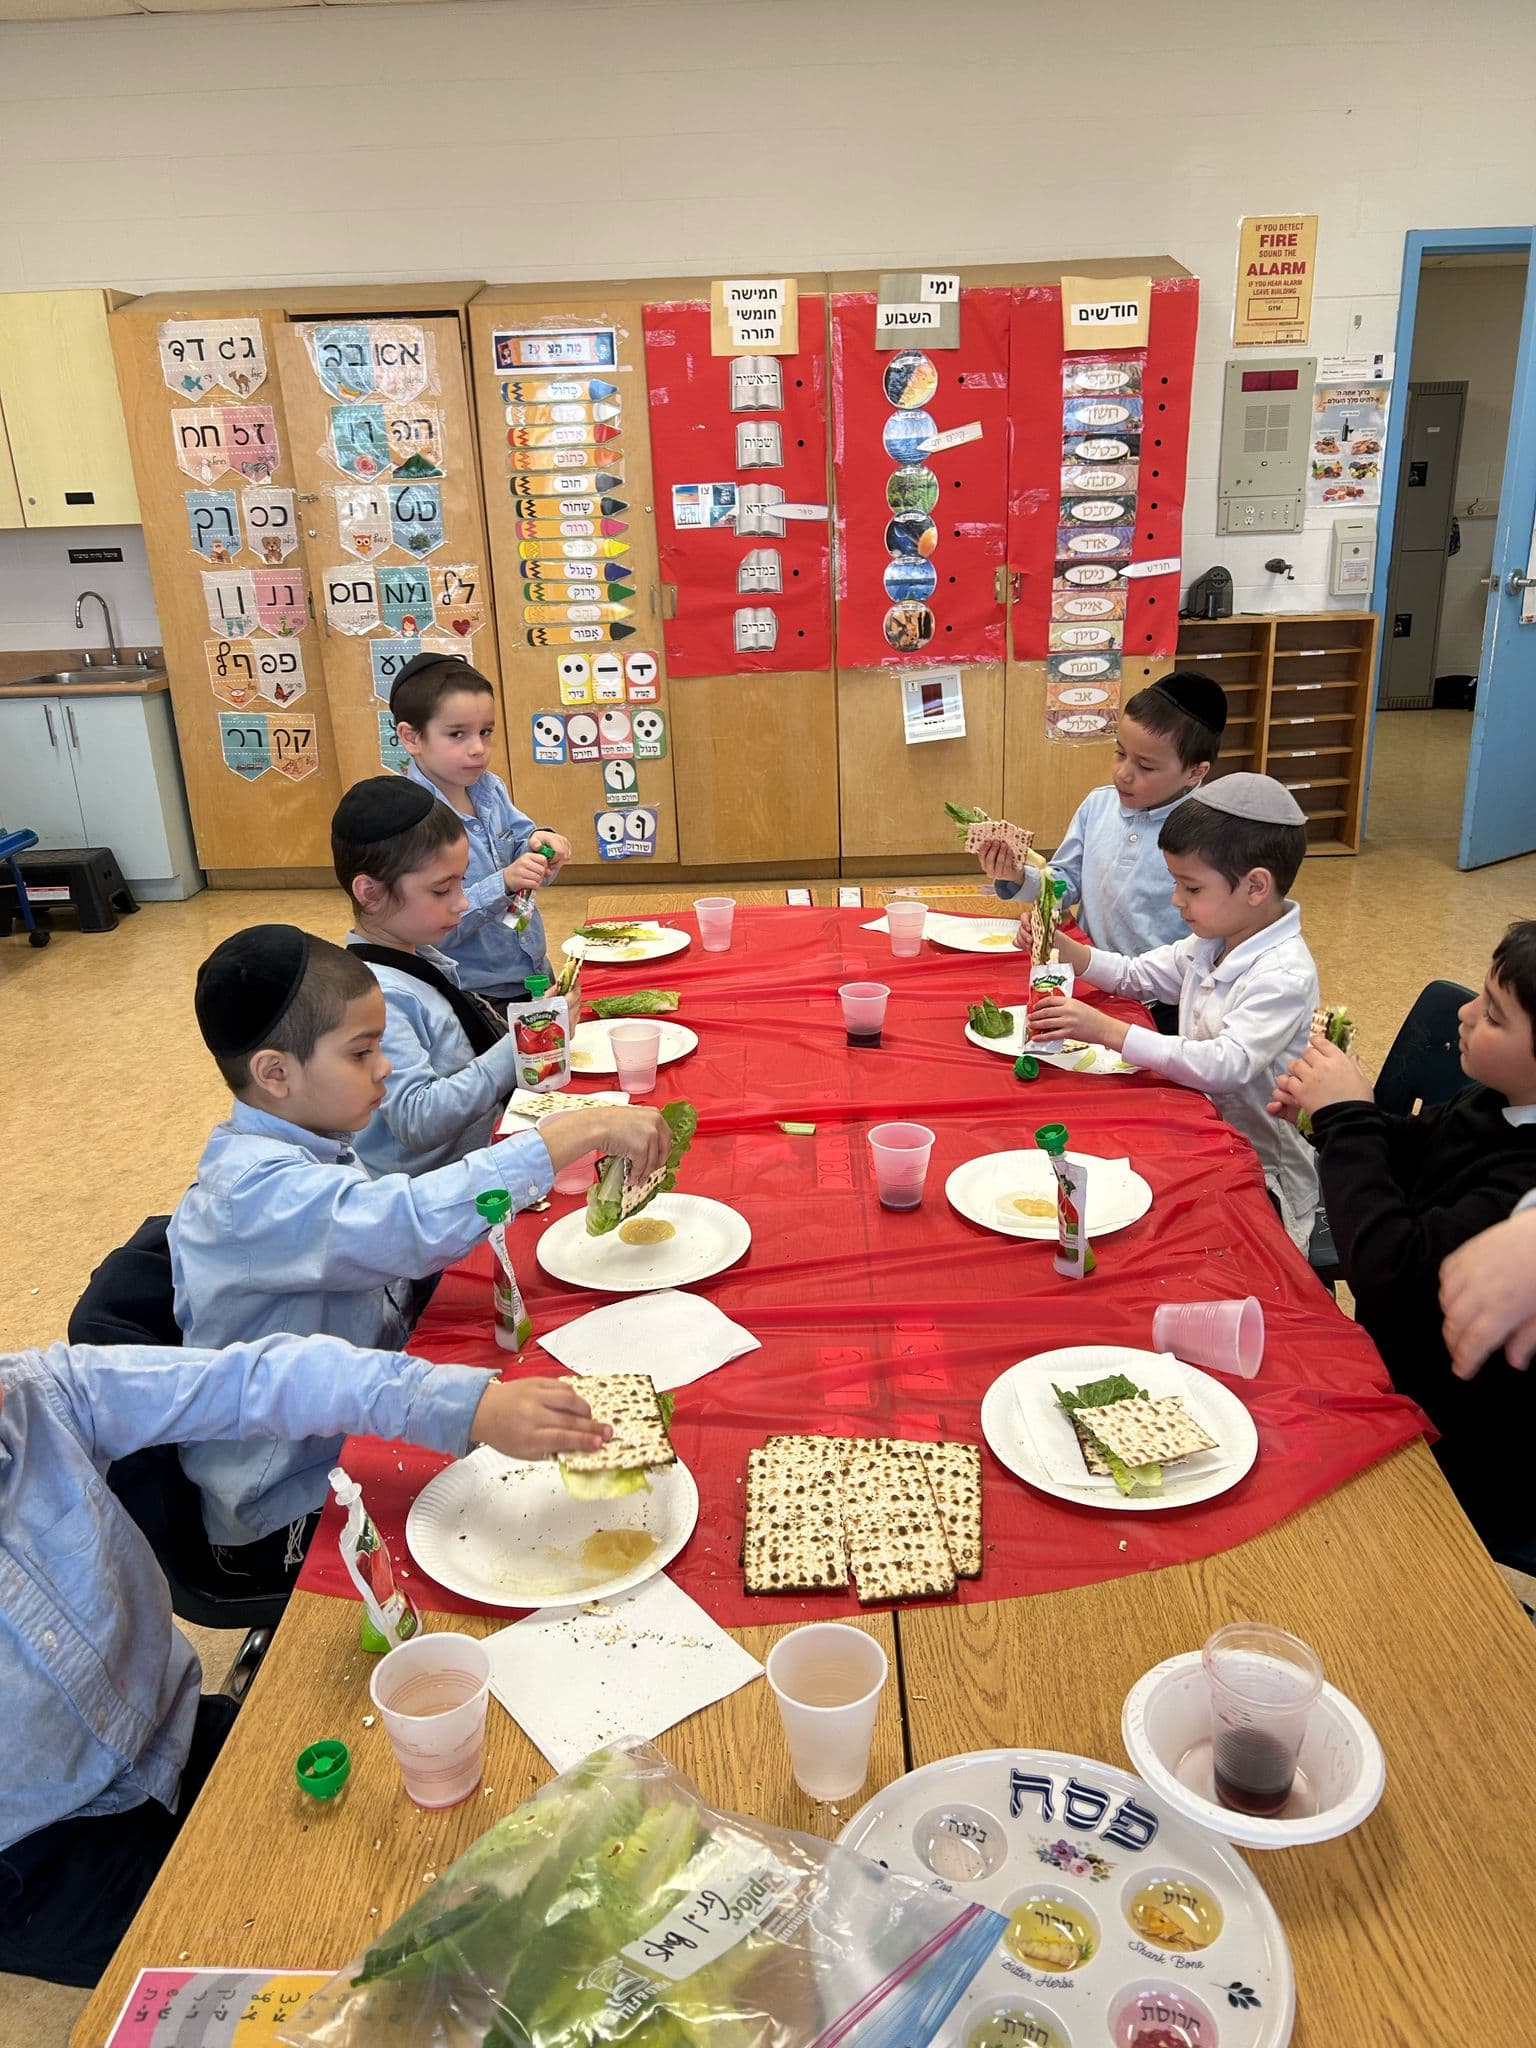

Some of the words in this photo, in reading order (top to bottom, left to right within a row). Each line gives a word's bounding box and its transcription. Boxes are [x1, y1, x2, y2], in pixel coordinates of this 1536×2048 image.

[1260, 234, 1298, 248] FIRE
[1259, 250, 1282, 258] SOUND
[1247, 262, 1306, 276] ALARM
[731, 288, 778, 300] חמישה
[930, 281, 952, 294] ימי
[1270, 288, 1296, 296] BUILDING
[736, 308, 776, 320] חומשי
[885, 312, 932, 326] השבוע
[1079, 304, 1138, 320] חודשים
[741, 328, 774, 340] תורה
[735, 372, 778, 386] בראשית
[1088, 408, 1119, 423] חשון
[744, 437, 774, 448] שמות
[1084, 444, 1120, 456] כסלו
[1082, 538, 1108, 549] אדר
[742, 565, 776, 576] במדבר
[1077, 568, 1104, 580] ניסן
[741, 622, 772, 633] דברים
[1074, 692, 1092, 702] אב
[1066, 716, 1098, 730] אלול
[1009, 1768, 1160, 1853] פסח
[948, 1819, 988, 1844] ביצה
[731, 1870, 790, 1923] Ziploc
[1162, 1888, 1199, 1910] זרוע
[1128, 1940, 1166, 1965] Shank
[1170, 1954, 1205, 1970] Bone
[1000, 1957, 1032, 1982] Bitter
[1034, 1974, 1074, 1989] Herbs
[1141, 2004, 1201, 2030] חרוסת
[1002, 2018, 1048, 2046] חזרת
